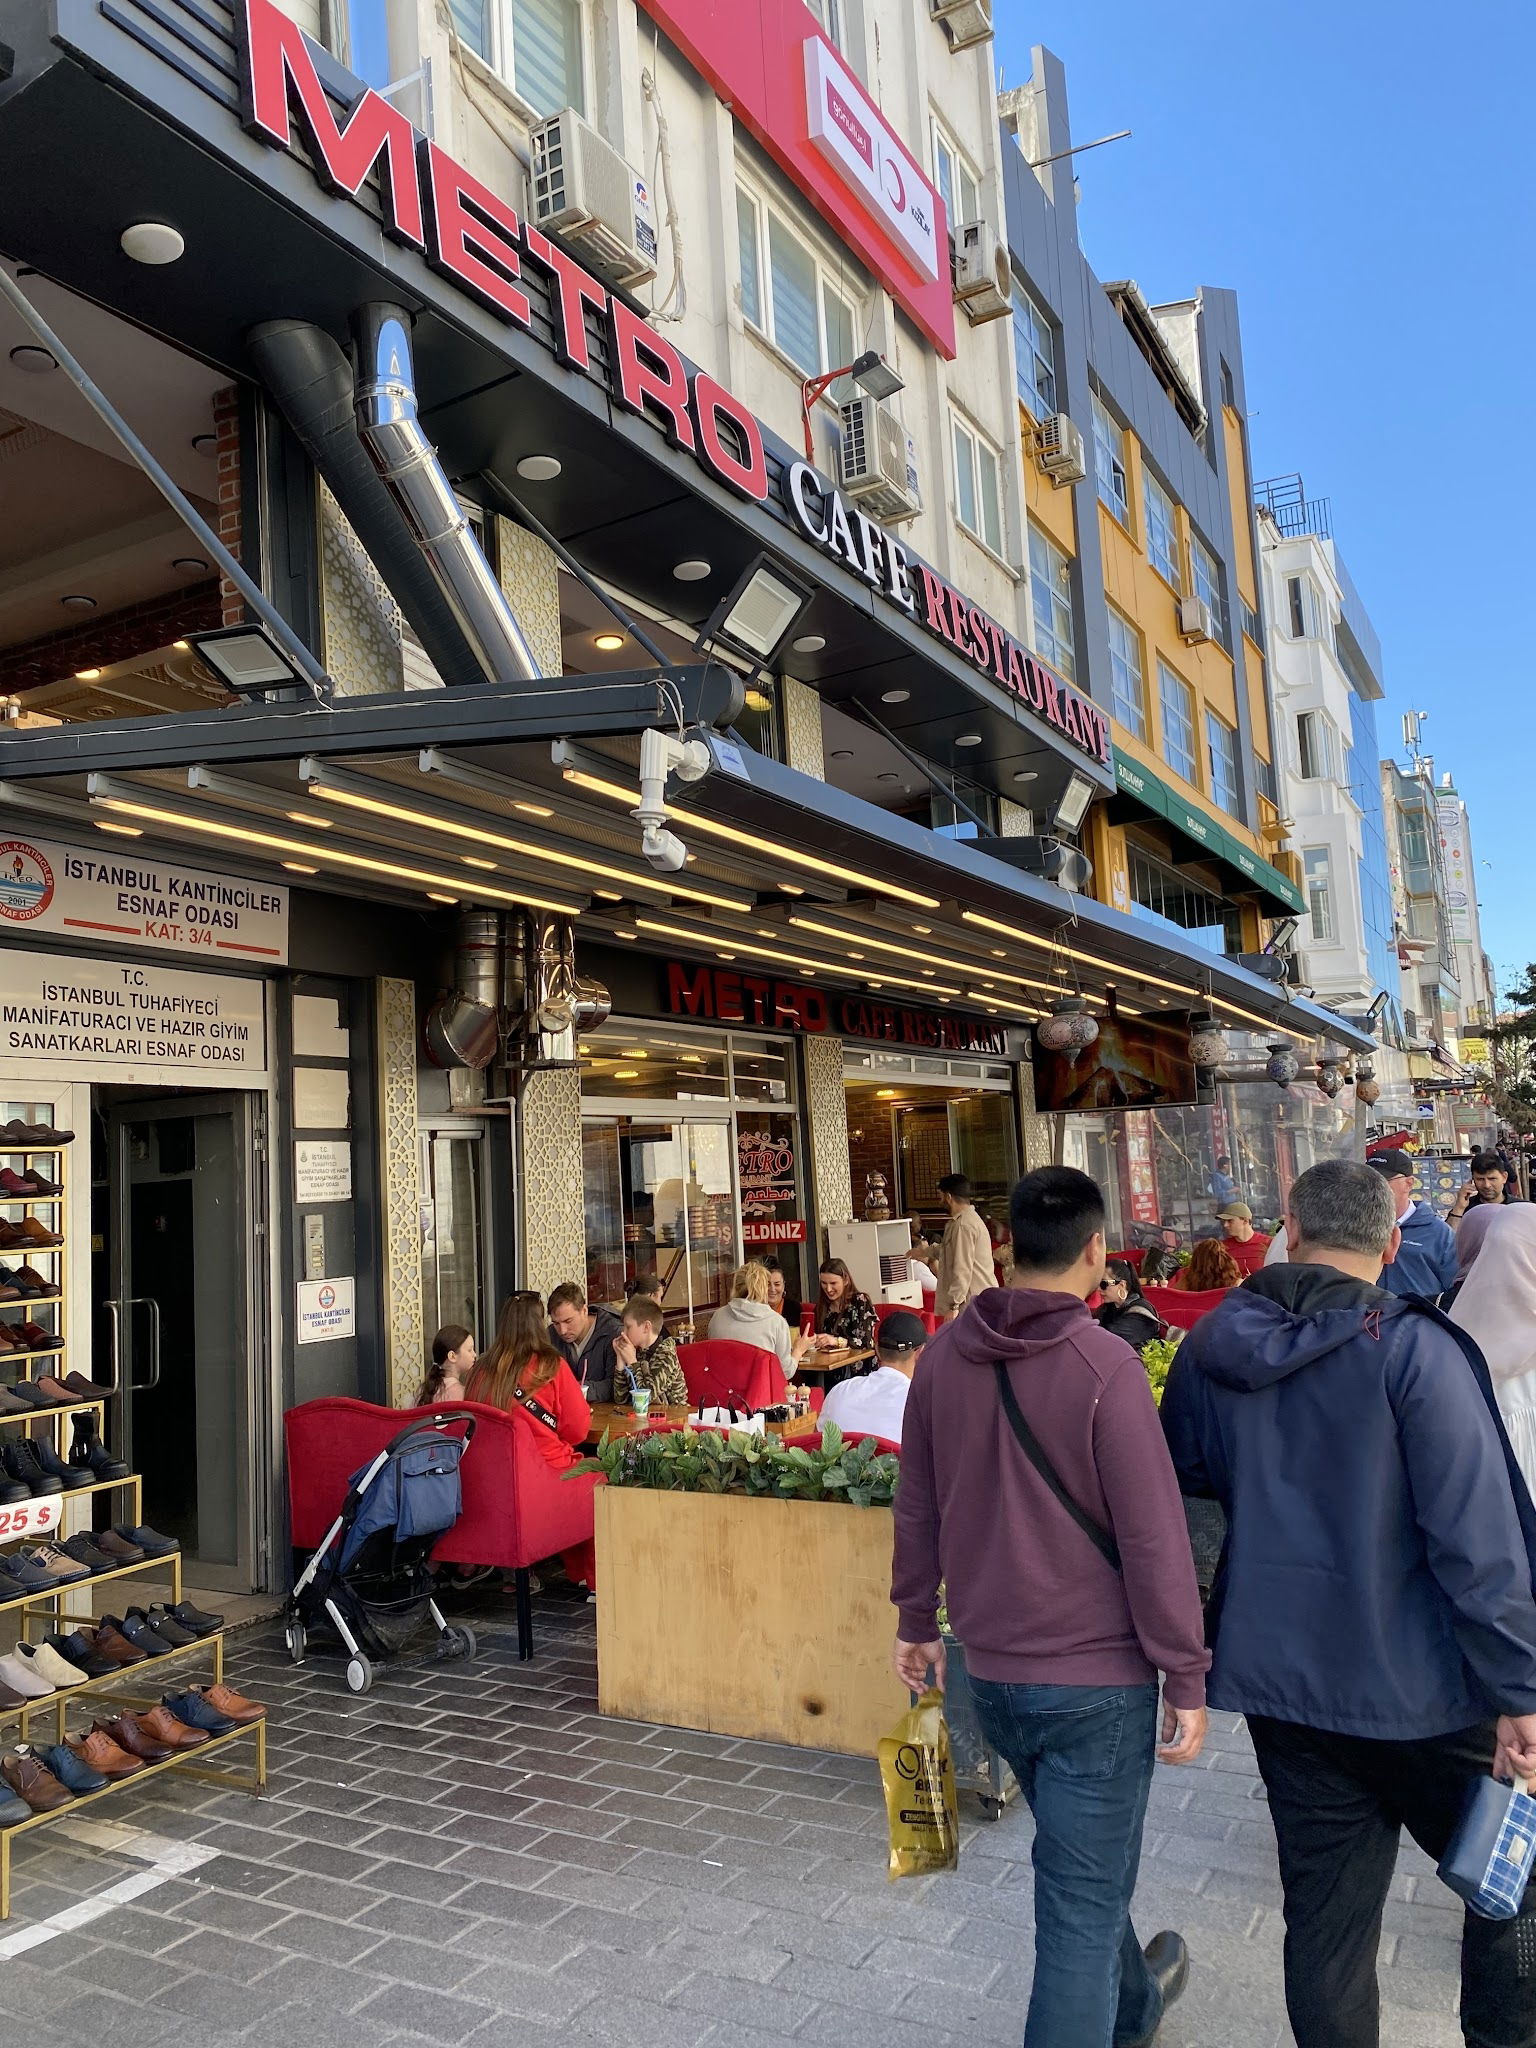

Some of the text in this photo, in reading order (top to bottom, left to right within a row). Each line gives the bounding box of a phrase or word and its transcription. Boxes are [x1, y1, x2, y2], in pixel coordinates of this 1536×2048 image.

[242, 0, 1112, 765] METRO CAFE RESTAURANT
[63, 853, 282, 915] İSTANBUL KANTİNCİLER
[8, 896, 27, 907] 2001
[117, 893, 239, 930] ESNAF ODASI
[145, 921, 213, 946] KAT: 3/4
[121, 969, 148, 987] T.C.
[42, 980, 219, 1017] İSTANBUL TUHAFİYECİ
[667, 962, 829, 1032] METRO
[842, 999, 899, 1041] CAFE
[902, 1010, 1011, 1056] RESTAURANT
[2, 1004, 249, 1042] MANİFATURACI VE HAZIR GİYİM
[8, 1031, 246, 1062] SANATKARLARI ESNAF ODASI
[738, 1149, 794, 1176] ETRO
[743, 1221, 802, 1241] ELDİNİZ
[0, 1506, 51, 1534] 25 $
